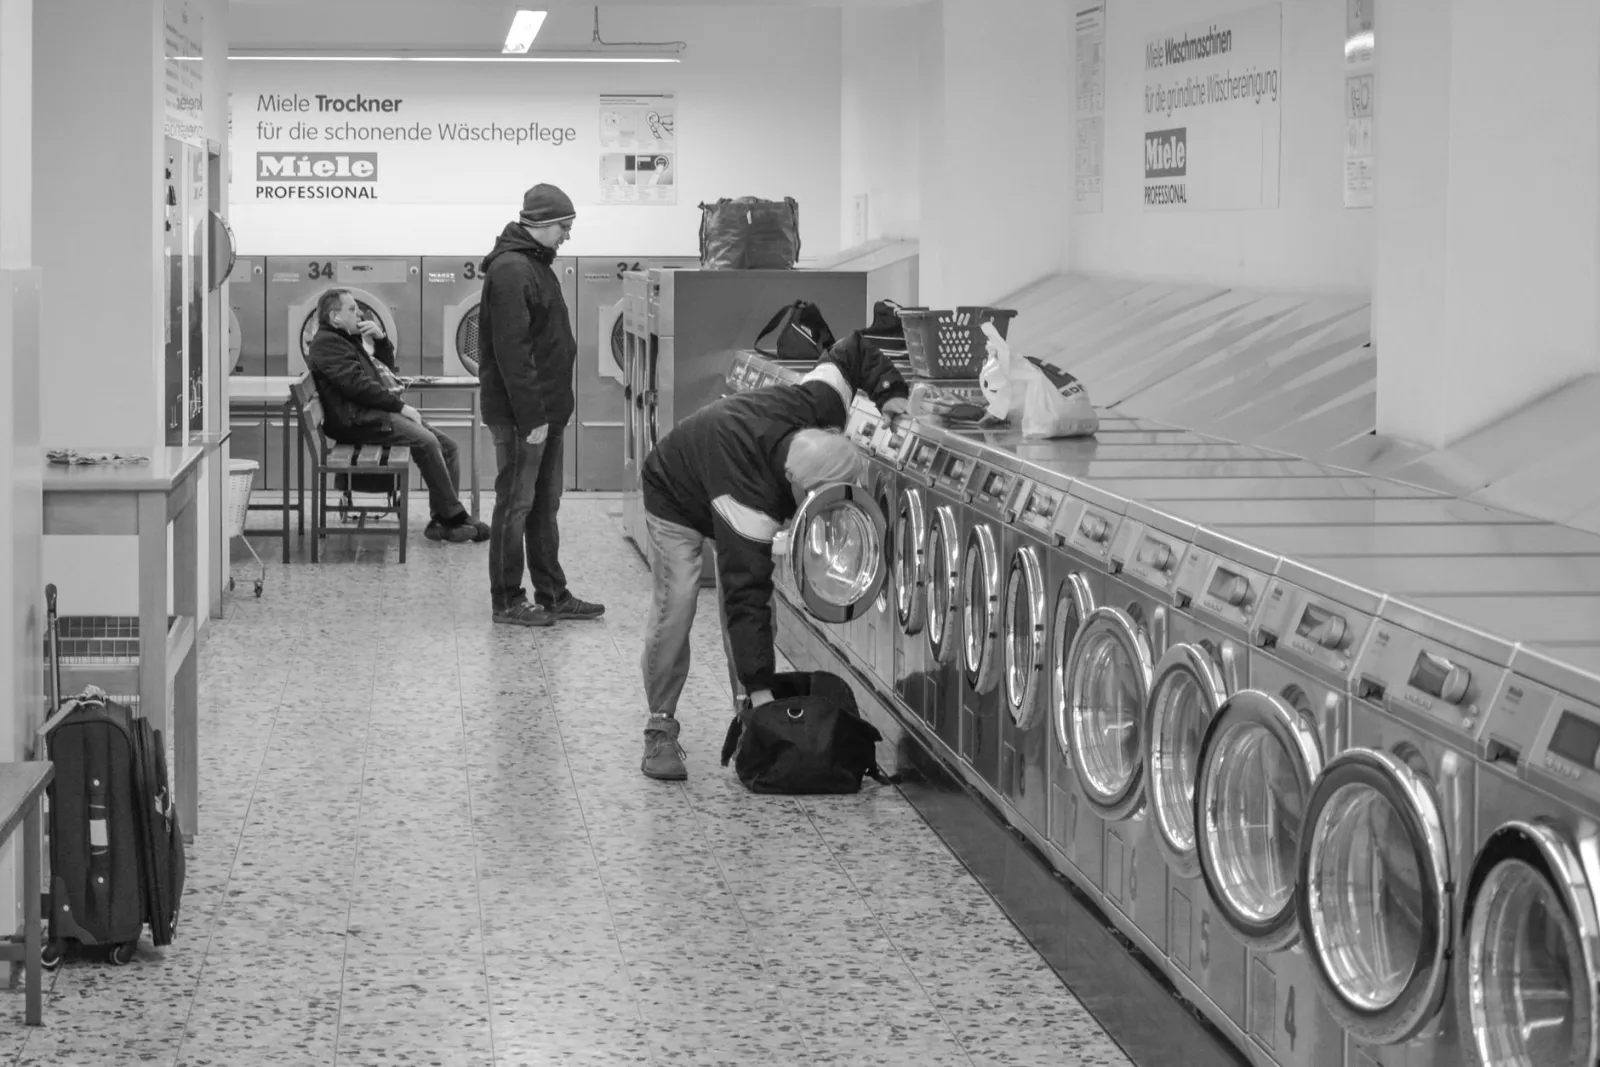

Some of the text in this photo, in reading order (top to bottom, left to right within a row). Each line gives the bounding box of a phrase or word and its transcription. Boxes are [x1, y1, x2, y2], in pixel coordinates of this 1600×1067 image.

[1145, 24, 1232, 71] Miele Waschmaschinen
[257, 94, 403, 113] Miele Trockner
[1155, 83, 1166, 112] die
[1167, 76, 1206, 118] gründliche
[1207, 66, 1278, 104] Wäschereinigung
[256, 121, 577, 146] für die schonende Wäschepflege
[1145, 135, 1186, 171] Miele
[259, 155, 375, 178] Miele
[256, 185, 378, 199] PROFESSIONAL
[1144, 183, 1187, 205] PROFESSIONAL
[308, 261, 334, 280] 34
[1200, 908, 1211, 970] 5
[1284, 984, 1297, 1053] 4
